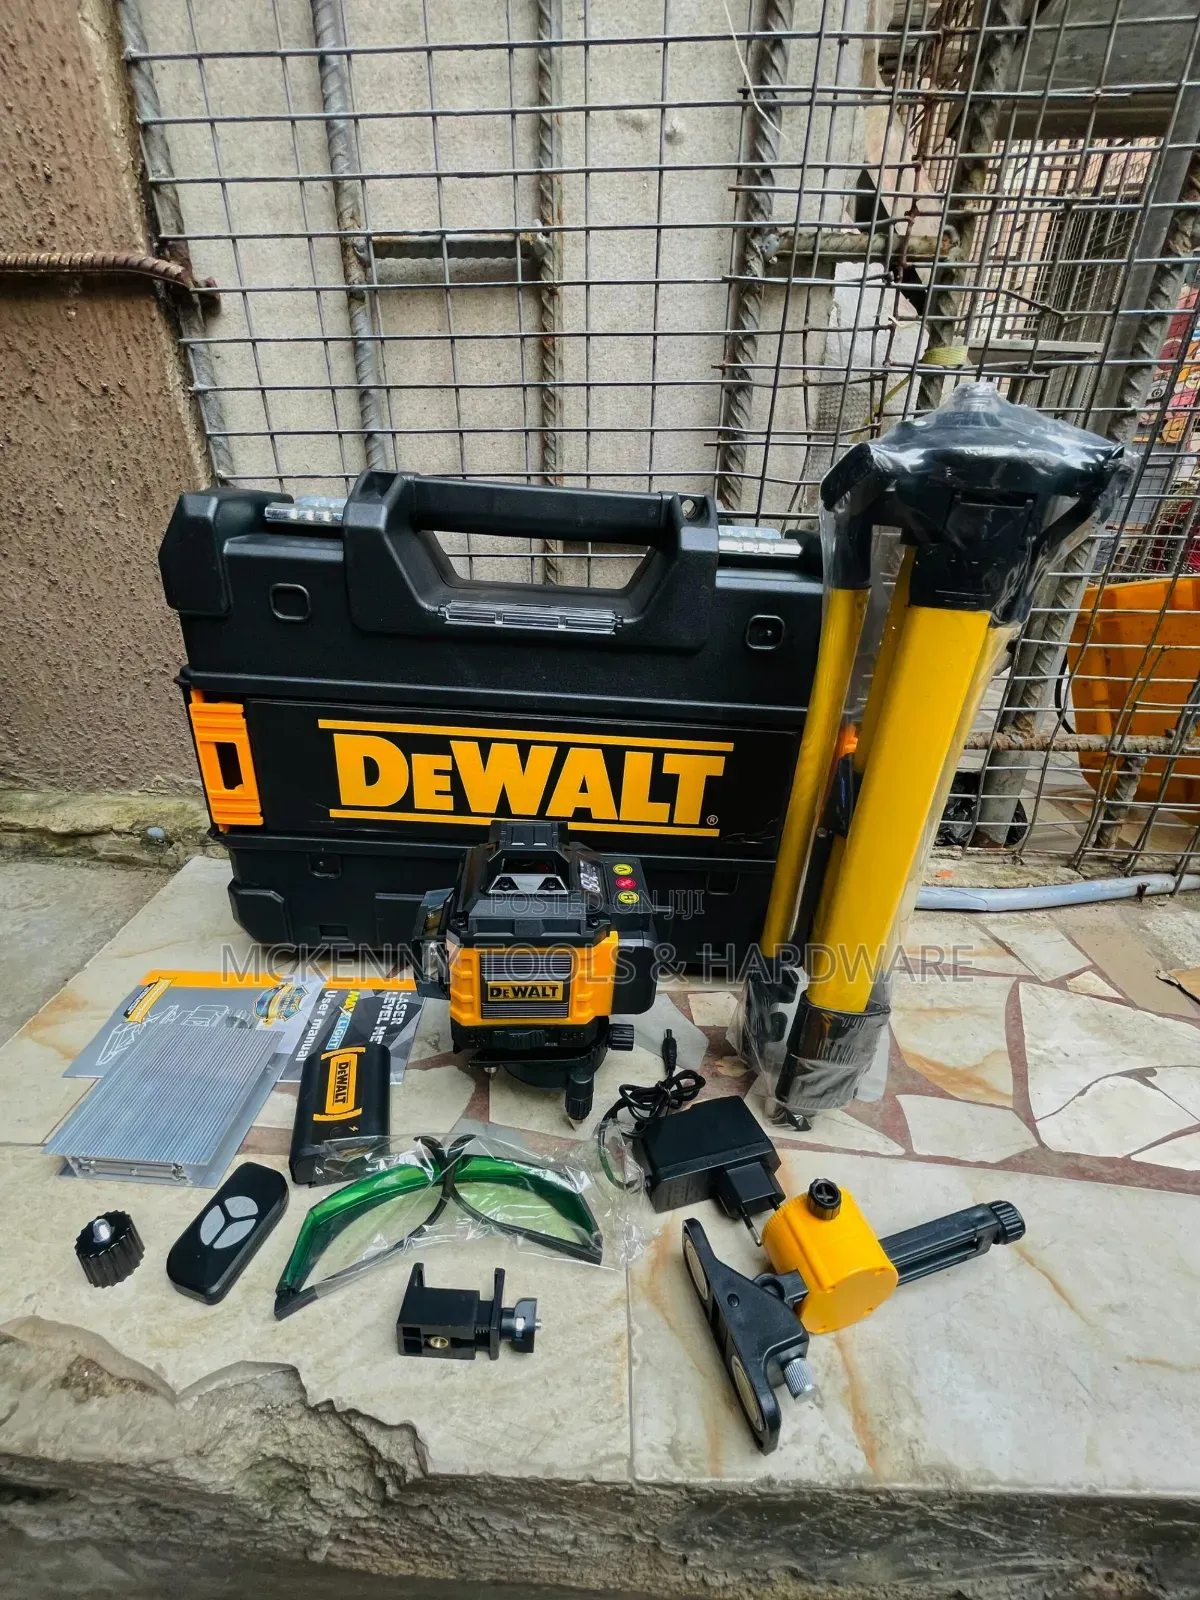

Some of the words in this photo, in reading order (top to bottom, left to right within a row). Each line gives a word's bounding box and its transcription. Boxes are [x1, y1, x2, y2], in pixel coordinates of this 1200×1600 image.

[319, 990, 338, 1016] User
[376, 991, 398, 1025] LEVEL
[390, 992, 411, 1025] LASER
[295, 1018, 322, 1061] manual
